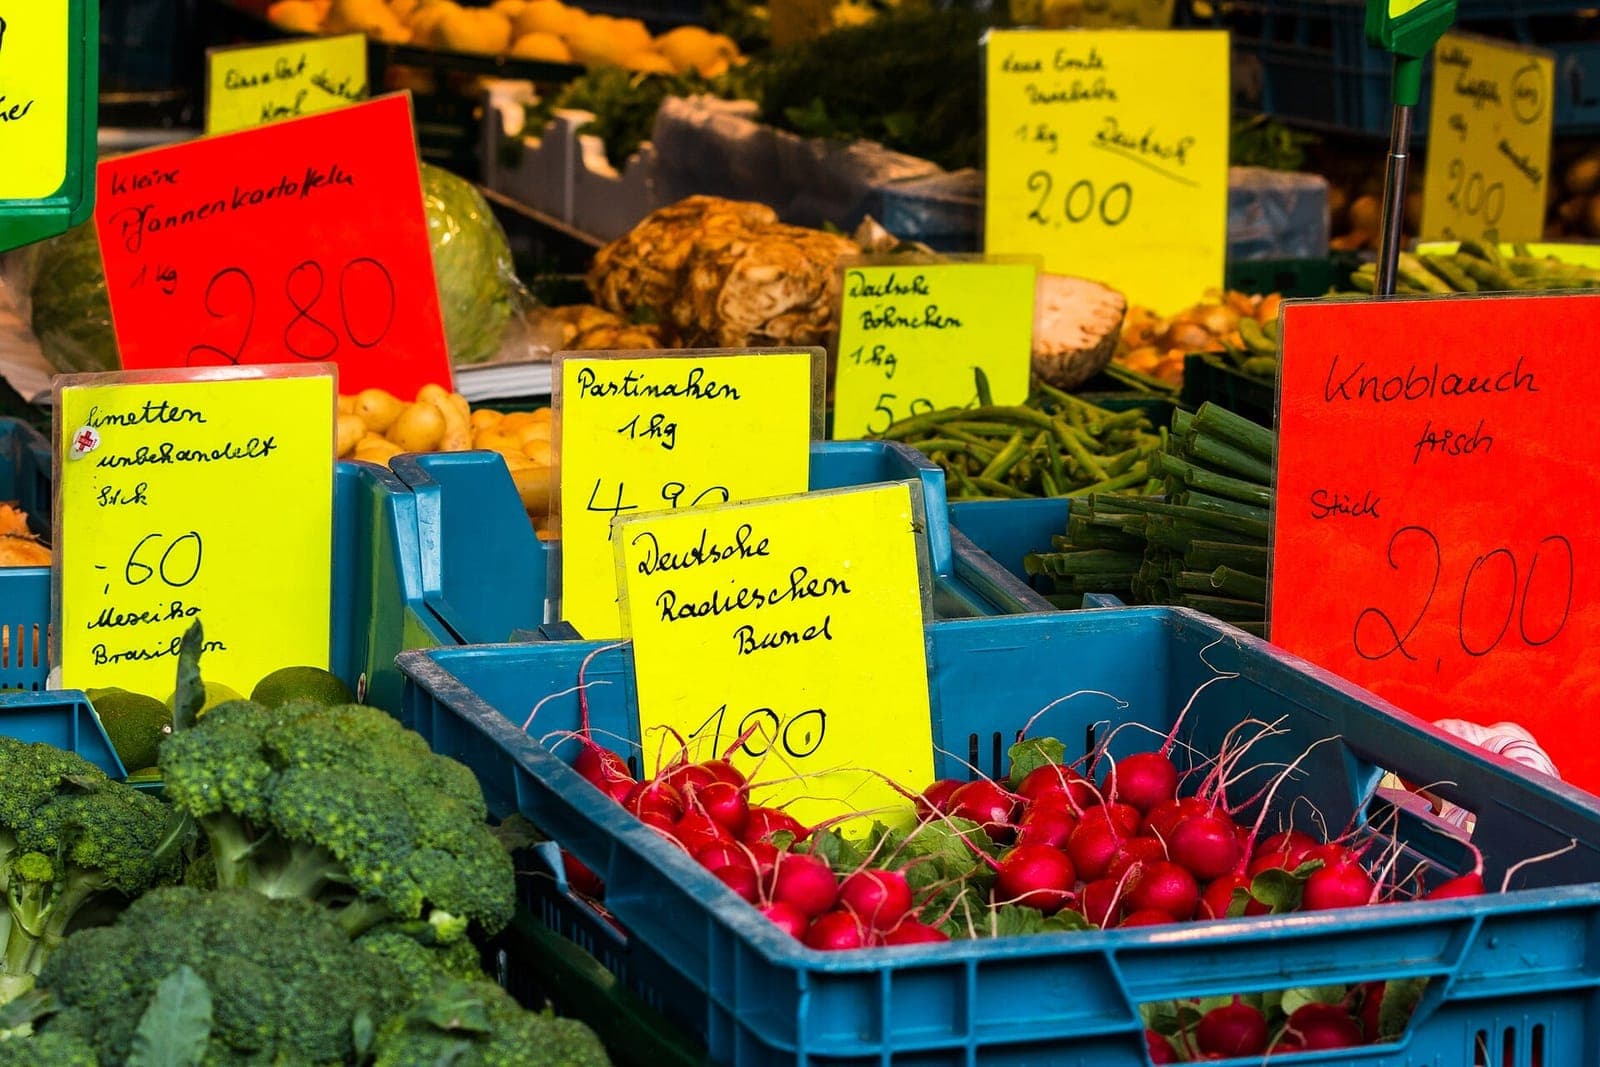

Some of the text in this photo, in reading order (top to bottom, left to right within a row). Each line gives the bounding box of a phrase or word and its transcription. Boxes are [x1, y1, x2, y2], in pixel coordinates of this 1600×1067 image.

[1324, 354, 1541, 403] Knoblauch
[95, 436, 278, 469] unbehandelt
[1412, 418, 1494, 465] frisch
[1310, 488, 1382, 520] Stück
[632, 523, 770, 577] Deutsche
[655, 565, 851, 622] Radieschen
[733, 614, 833, 656] Bund
